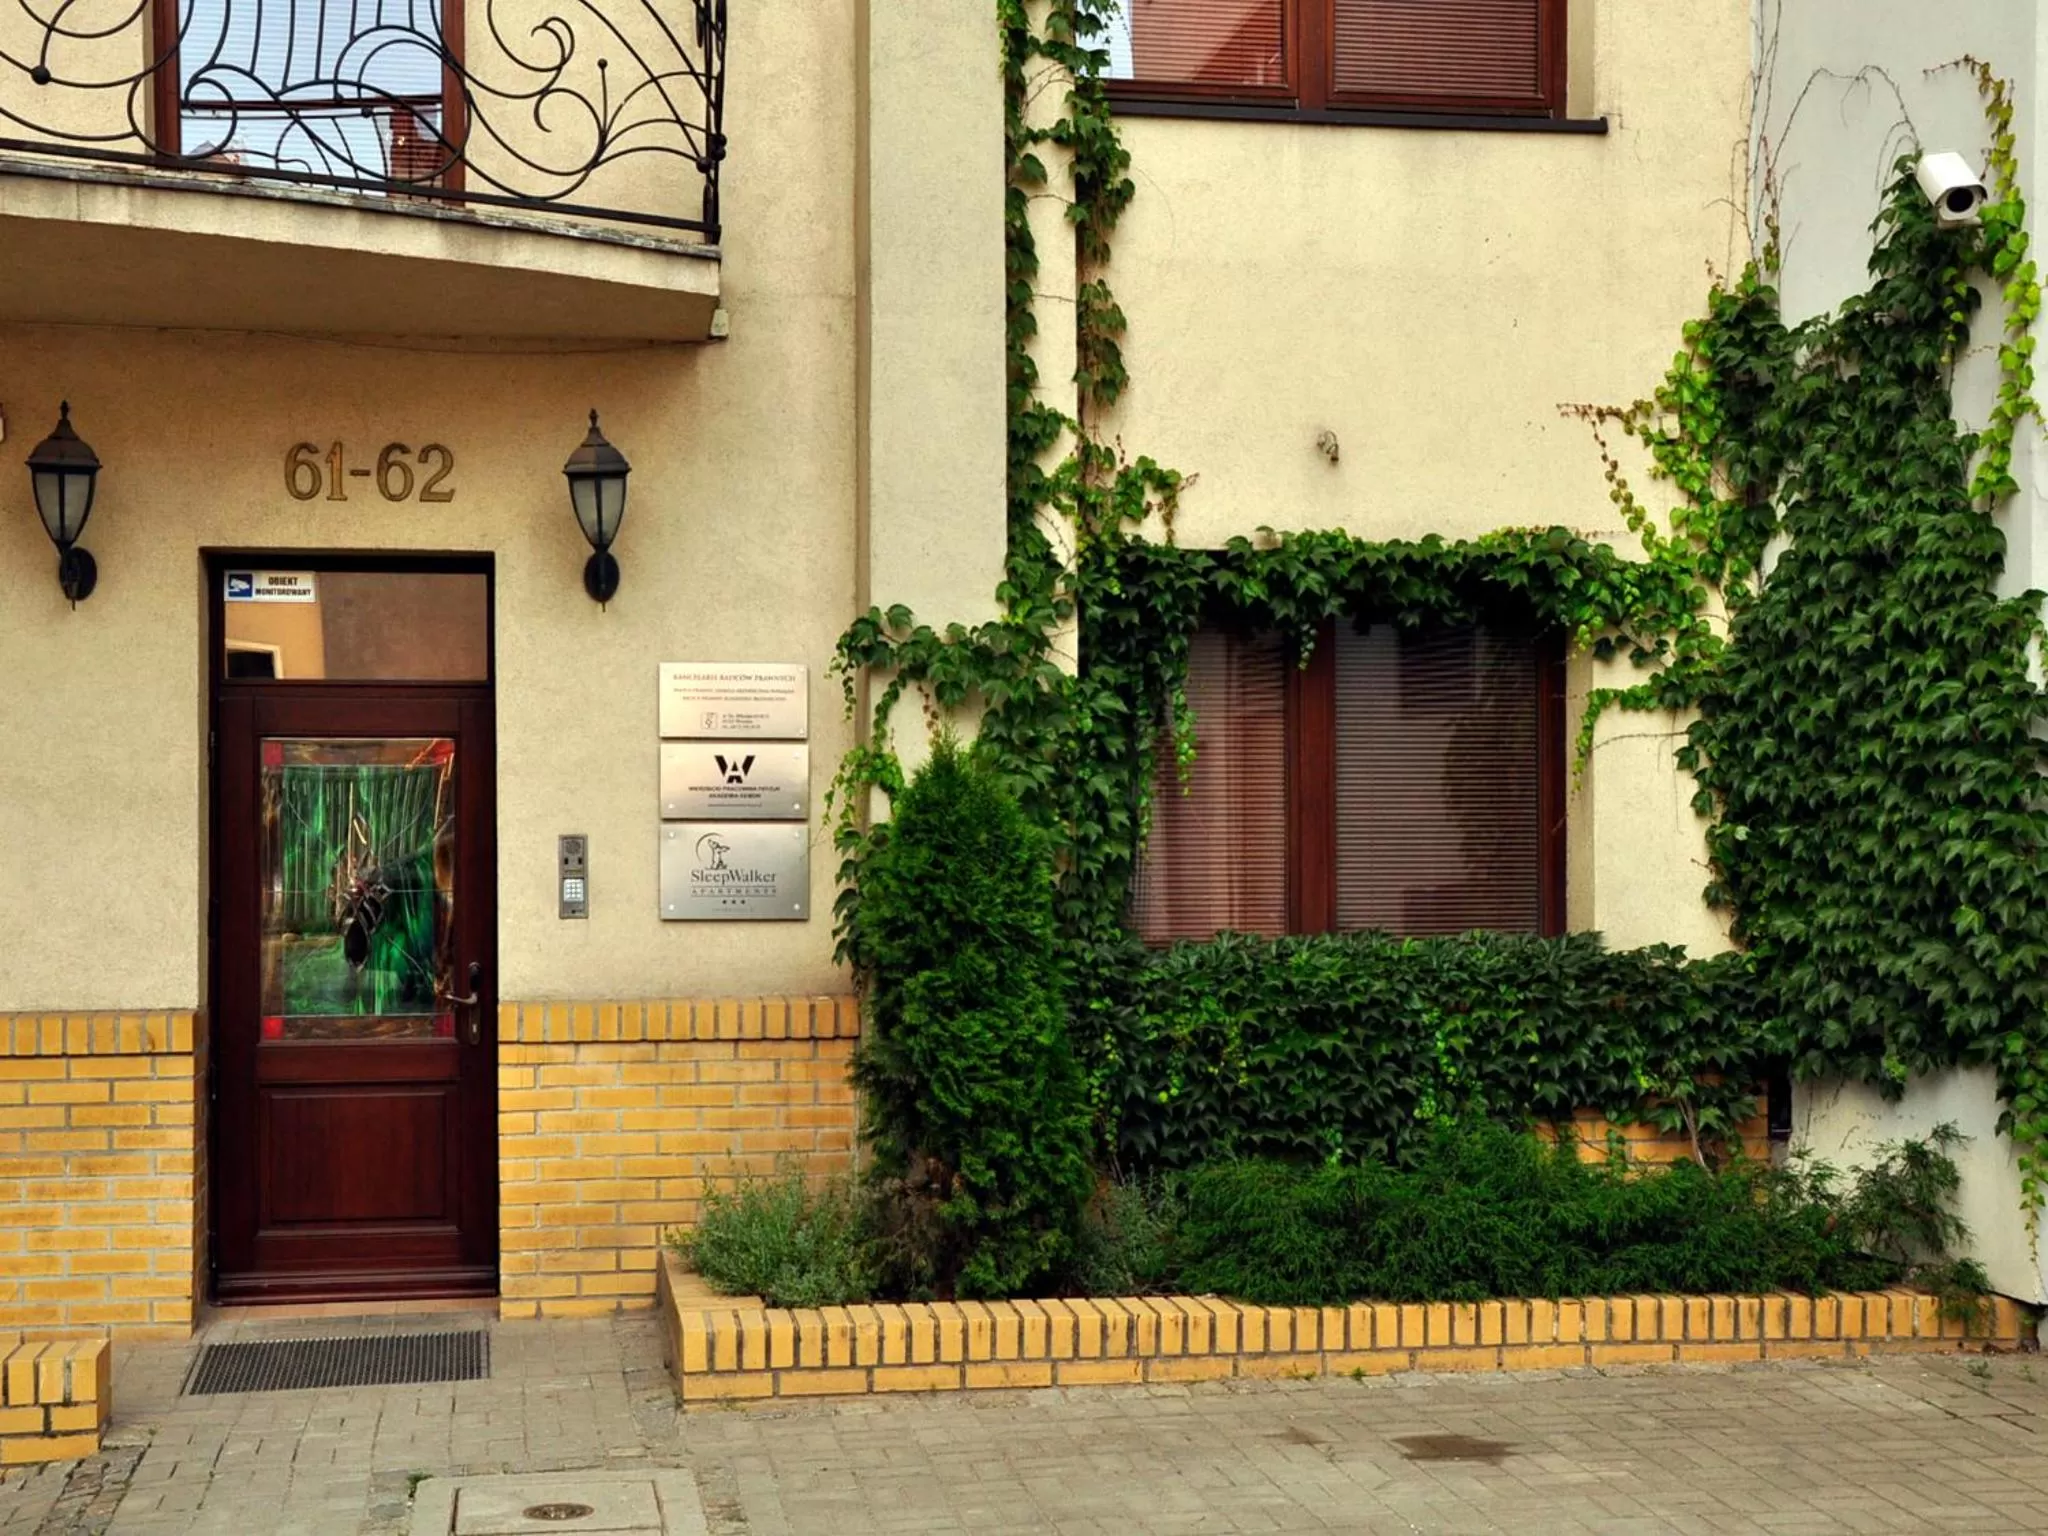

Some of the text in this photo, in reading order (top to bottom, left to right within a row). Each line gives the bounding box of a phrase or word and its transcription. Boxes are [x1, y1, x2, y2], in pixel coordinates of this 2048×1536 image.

[284, 441, 456, 503] 61-62
[268, 576, 298, 586] OBIEKT
[255, 588, 312, 596] MONITOROWANY
[691, 869, 777, 885] SleepWalker
